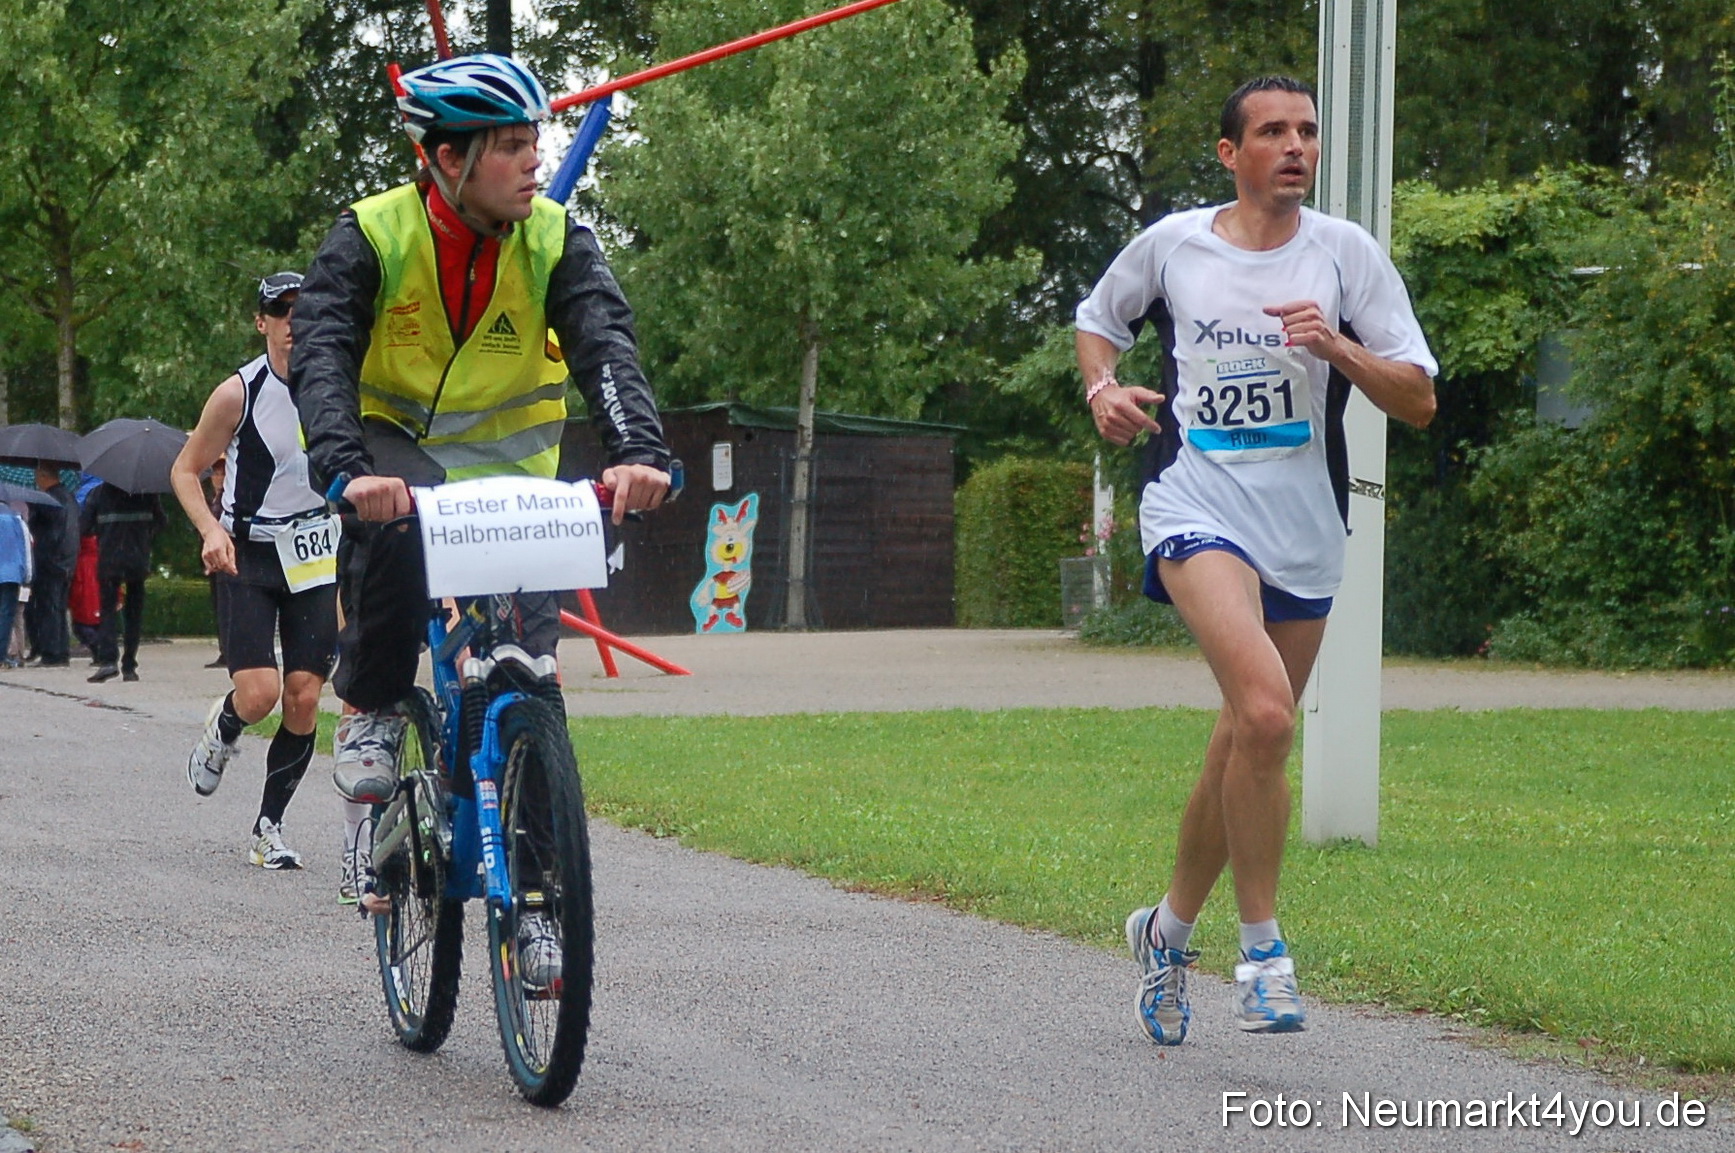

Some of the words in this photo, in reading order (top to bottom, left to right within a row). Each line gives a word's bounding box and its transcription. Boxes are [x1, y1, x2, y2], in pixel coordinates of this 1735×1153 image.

[1194, 319, 1281, 349] Xplus
[1197, 379, 1294, 426] 3251
[437, 499, 508, 516] Erster
[517, 494, 583, 510] Mann
[294, 529, 332, 561] 684
[430, 519, 599, 545] Halbmarathon
